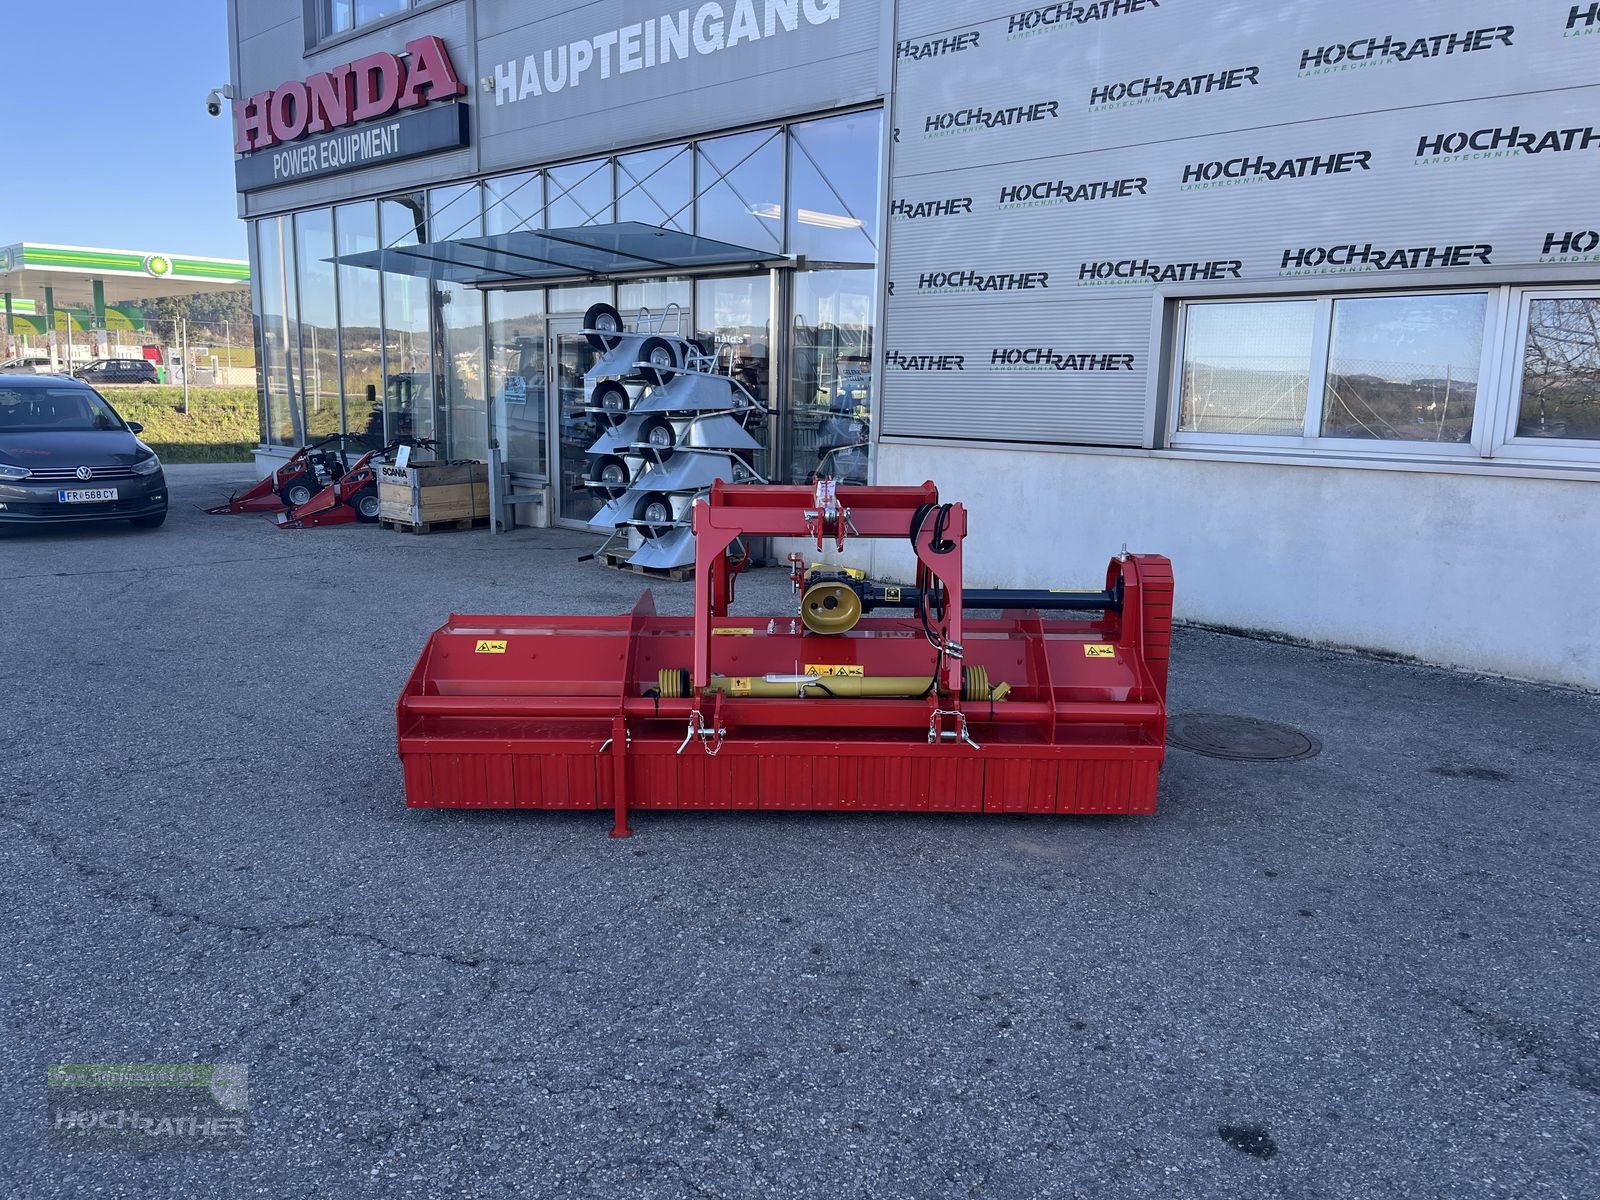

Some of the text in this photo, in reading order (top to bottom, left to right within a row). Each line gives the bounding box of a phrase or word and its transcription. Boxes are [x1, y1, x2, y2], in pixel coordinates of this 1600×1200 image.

[1006, 21, 1075, 41] LANDTECHNIK
[495, 0, 840, 106] HAUPTEINGANG
[1299, 25, 1515, 69] HOCHRATHER
[1297, 57, 1393, 78] LANDTECHNIK
[234, 35, 467, 154] HONDA
[1089, 67, 1259, 105] HOCHRATHER
[1088, 95, 1164, 112] LANDTECHNIK
[924, 101, 1059, 132] HOCHRATHER
[923, 125, 984, 139] LANDTECHNIK
[273, 123, 400, 179] POWER EQUIPMENT
[1414, 149, 1521, 166] LANDTECHNIK
[1181, 150, 1372, 183] HOCHRATHER
[1000, 177, 1147, 203] HOCHRATHER
[1180, 176, 1264, 191] LANDTECHNIK
[998, 198, 1064, 210] LANDTECHNIK
[1281, 244, 1492, 270] HOCHRATHER
[918, 270, 1049, 291] HOCHRATHER
[1078, 259, 1243, 282] HOCHRATHER
[1279, 265, 1372, 276] LANDTECHNIK
[1077, 278, 1149, 287] LANDTECHNIK
[990, 348, 1135, 371] HOCHRATHER
[382, 467, 408, 478] SCANIA
[66, 490, 114, 500] FR 568 CY
